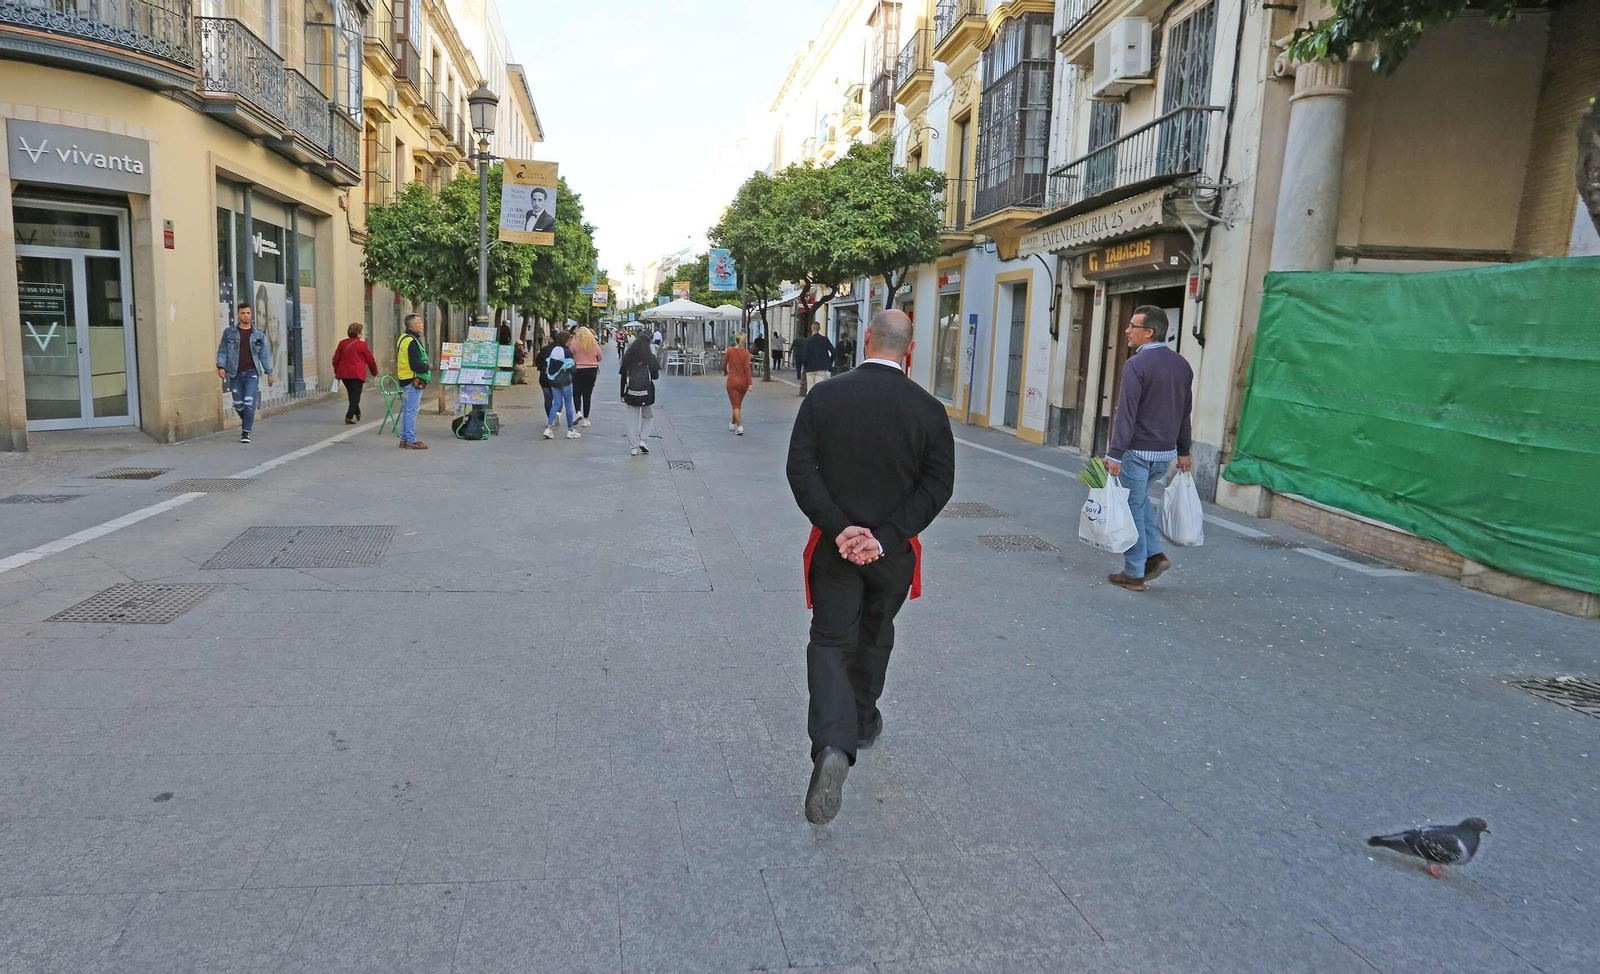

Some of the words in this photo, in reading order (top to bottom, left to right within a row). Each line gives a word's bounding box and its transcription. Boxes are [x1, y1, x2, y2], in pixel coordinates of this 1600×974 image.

[56, 144, 144, 174] vivanta
[1042, 215, 1108, 247] EXPENDEDURIA
[1111, 210, 1124, 229] 25
[1105, 239, 1152, 263] TABACOS
